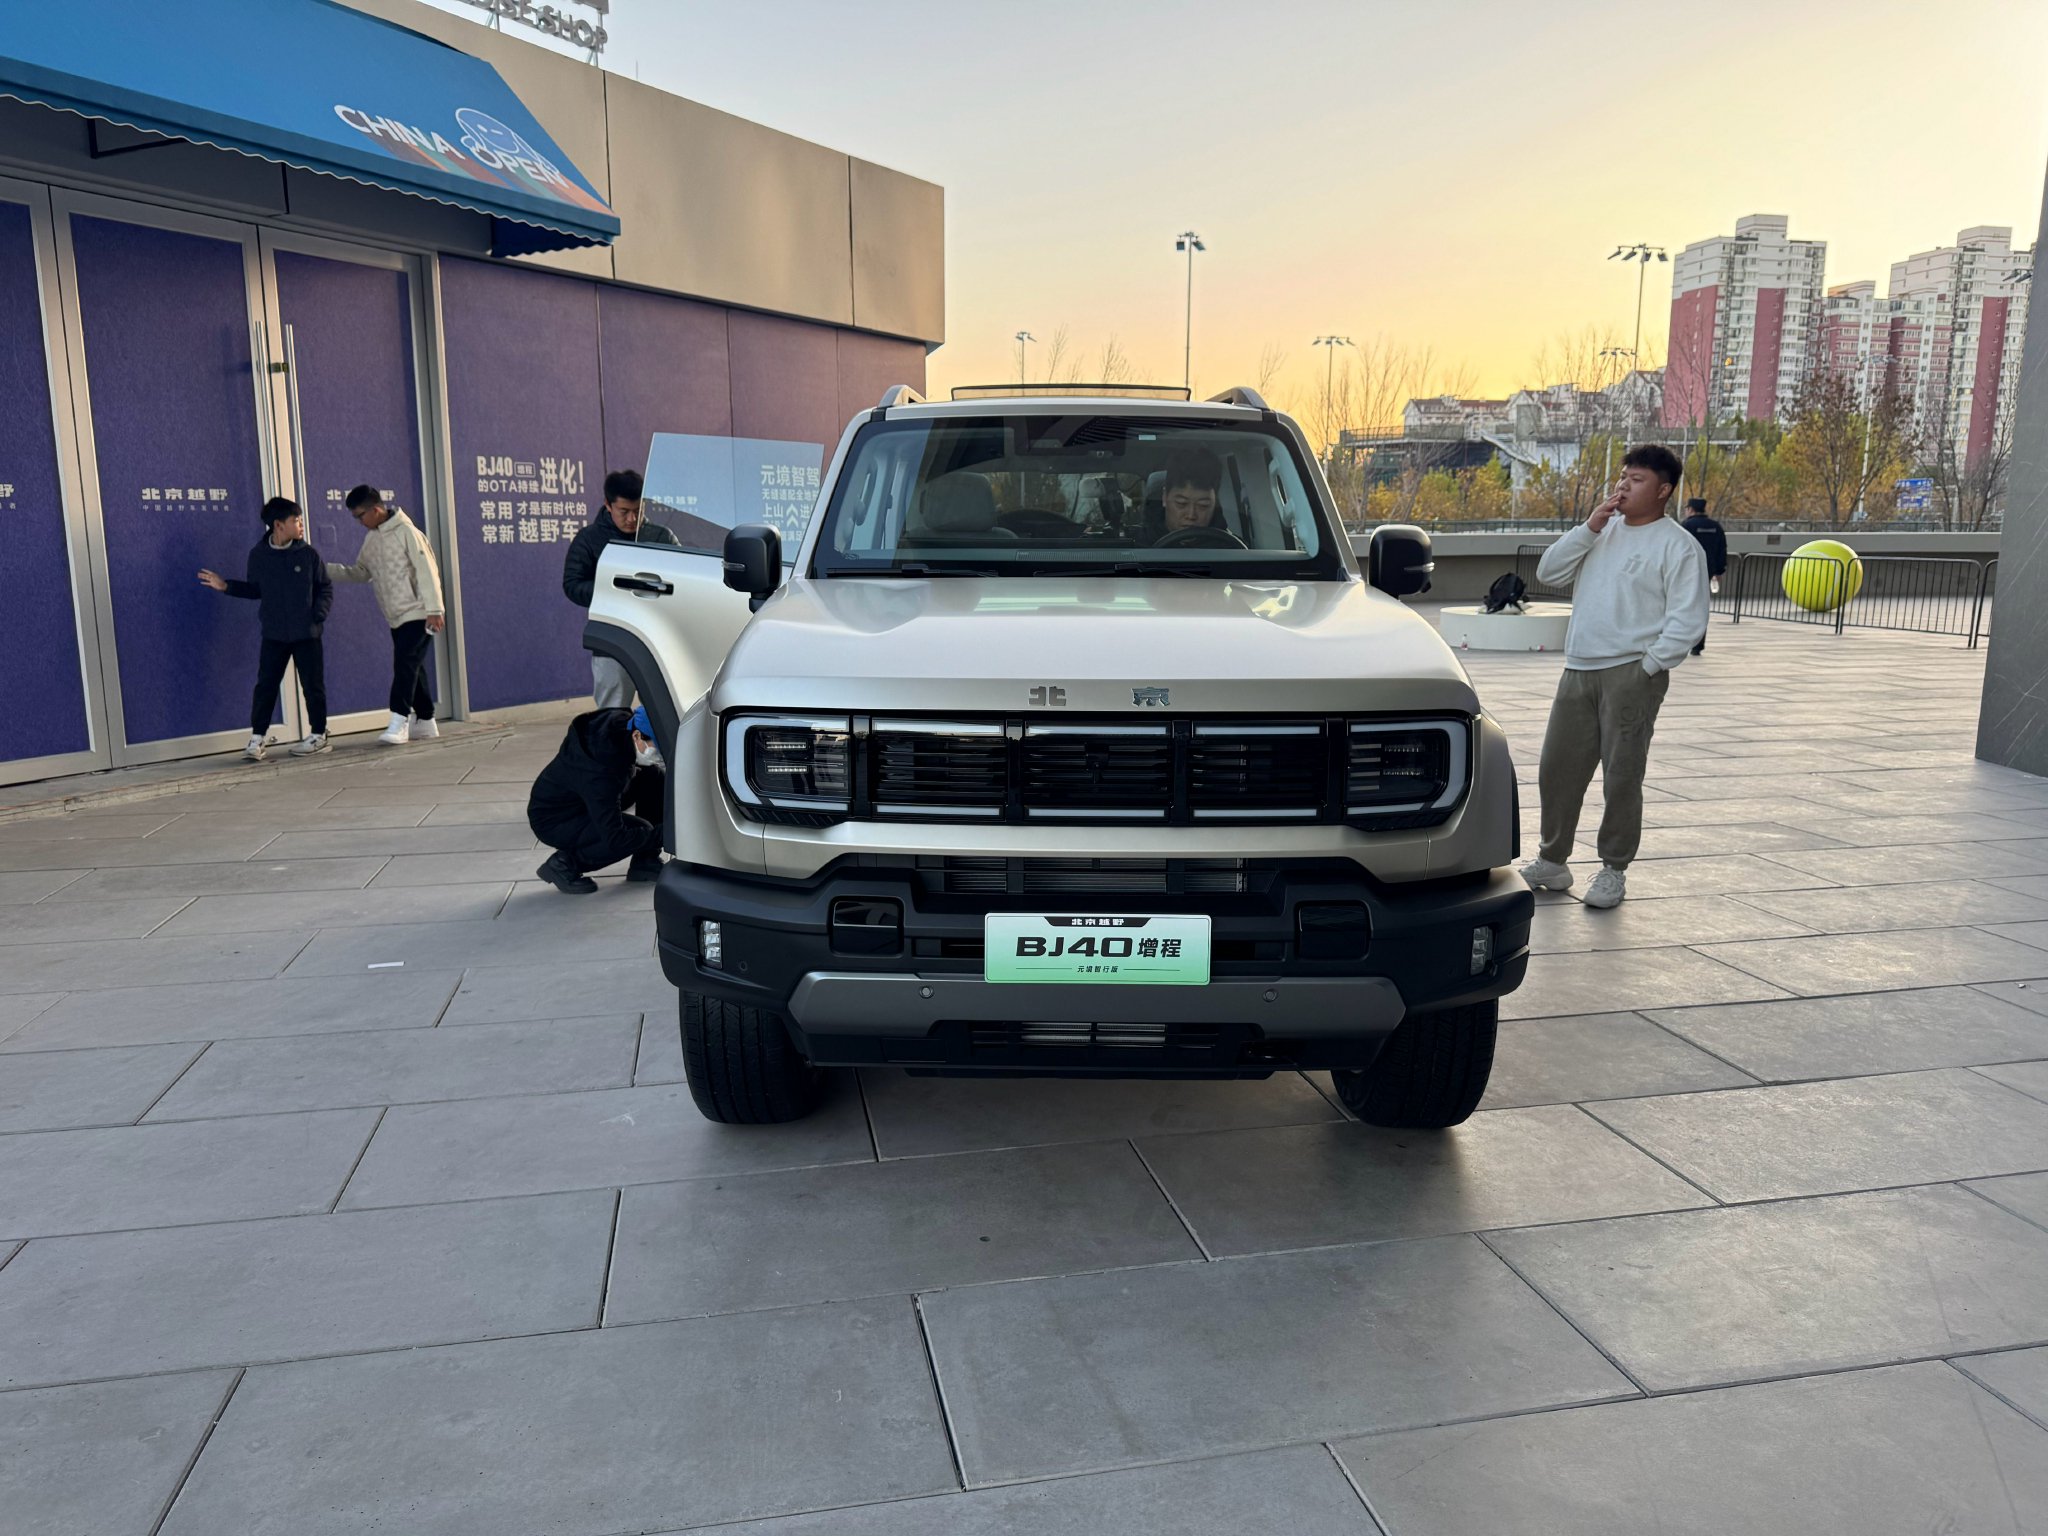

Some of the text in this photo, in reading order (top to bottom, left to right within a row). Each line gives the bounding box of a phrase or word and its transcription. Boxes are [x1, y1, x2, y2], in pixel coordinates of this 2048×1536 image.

[537, 5, 608, 53] SHOP
[334, 105, 570, 189] CHINA OPEN
[477, 456, 514, 477] BJ40
[760, 465, 820, 487] 元境智驾
[142, 488, 228, 501] 北京越野
[326, 489, 395, 501] 北野
[478, 479, 540, 494] 的OTA持续
[480, 501, 588, 520] 常用 才是新时代的
[762, 503, 784, 518] 上山
[482, 524, 515, 544] 常新
[1071, 918, 1125, 926] 北京越野
